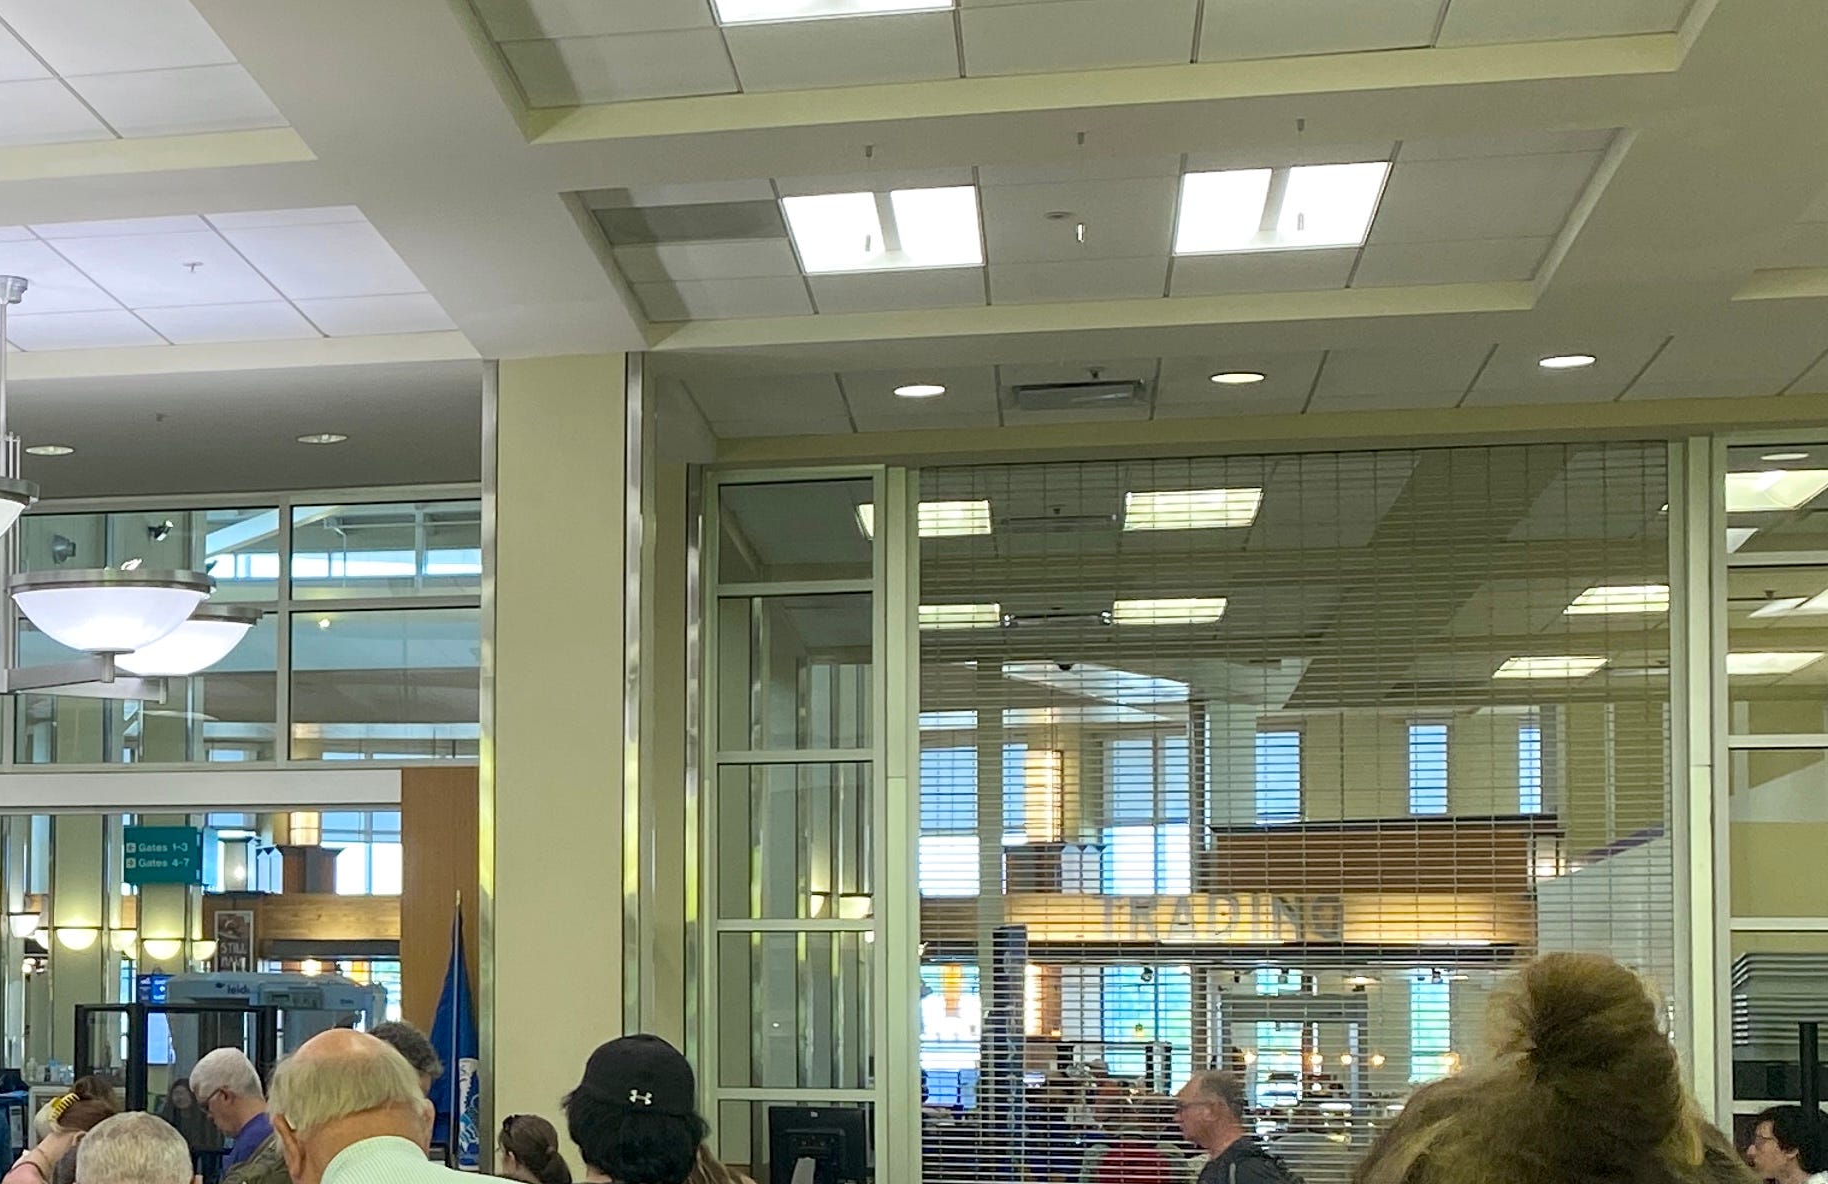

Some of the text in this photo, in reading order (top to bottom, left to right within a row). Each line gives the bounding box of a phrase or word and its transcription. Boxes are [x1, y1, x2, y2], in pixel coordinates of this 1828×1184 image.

[138, 843, 168, 852] Gates
[138, 858, 190, 867] Gates 4-7
